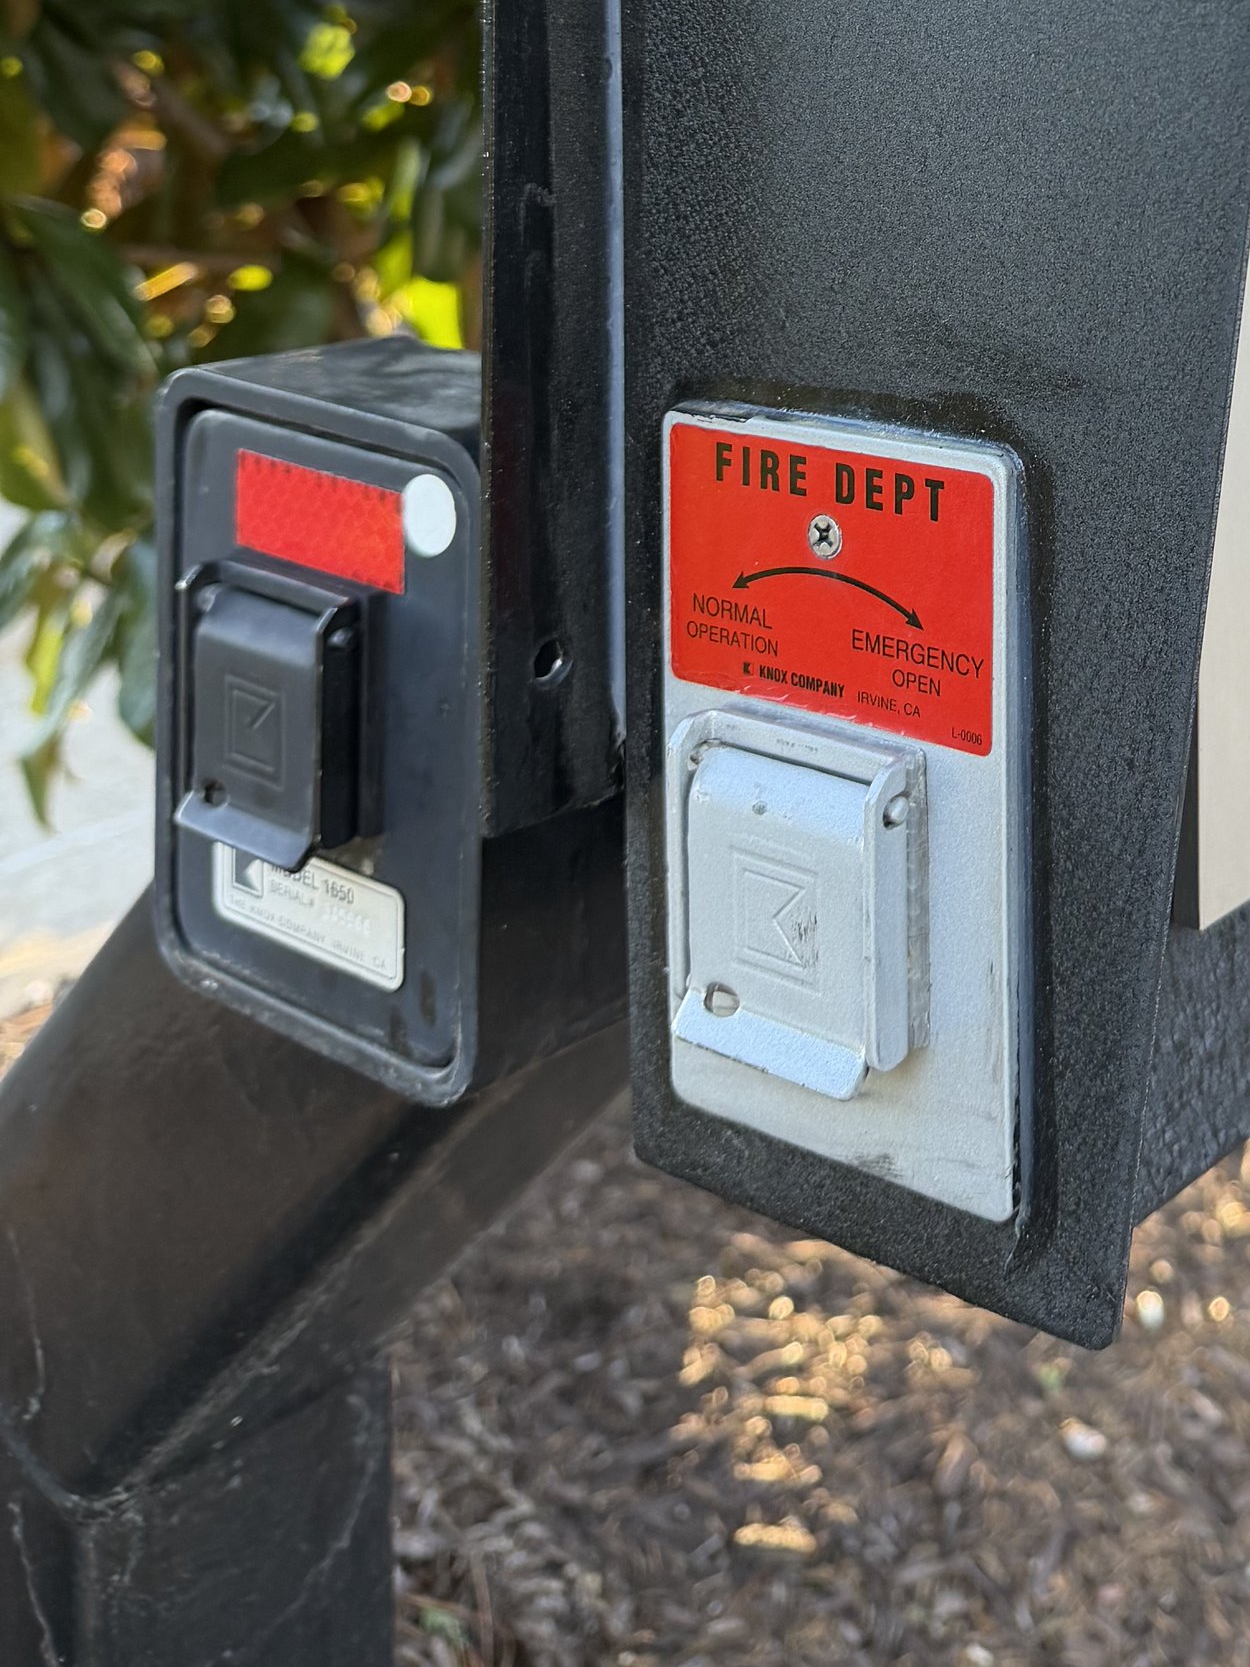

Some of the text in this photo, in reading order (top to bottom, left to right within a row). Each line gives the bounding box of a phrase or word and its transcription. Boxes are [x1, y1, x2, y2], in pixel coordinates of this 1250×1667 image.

[715, 441, 945, 522] FIRE DEPT
[692, 593, 773, 630] NORMAL
[686, 620, 779, 657] OPERATION
[851, 628, 985, 679] EMERGENCY
[759, 664, 788, 685] KNOX
[790, 672, 845, 698] COMPANY
[857, 691, 900, 715] IRVINE,
[903, 702, 921, 718] CA
[892, 669, 941, 697] OPEN
[951, 726, 983, 746] L-0006
[322, 878, 354, 904] 1650
